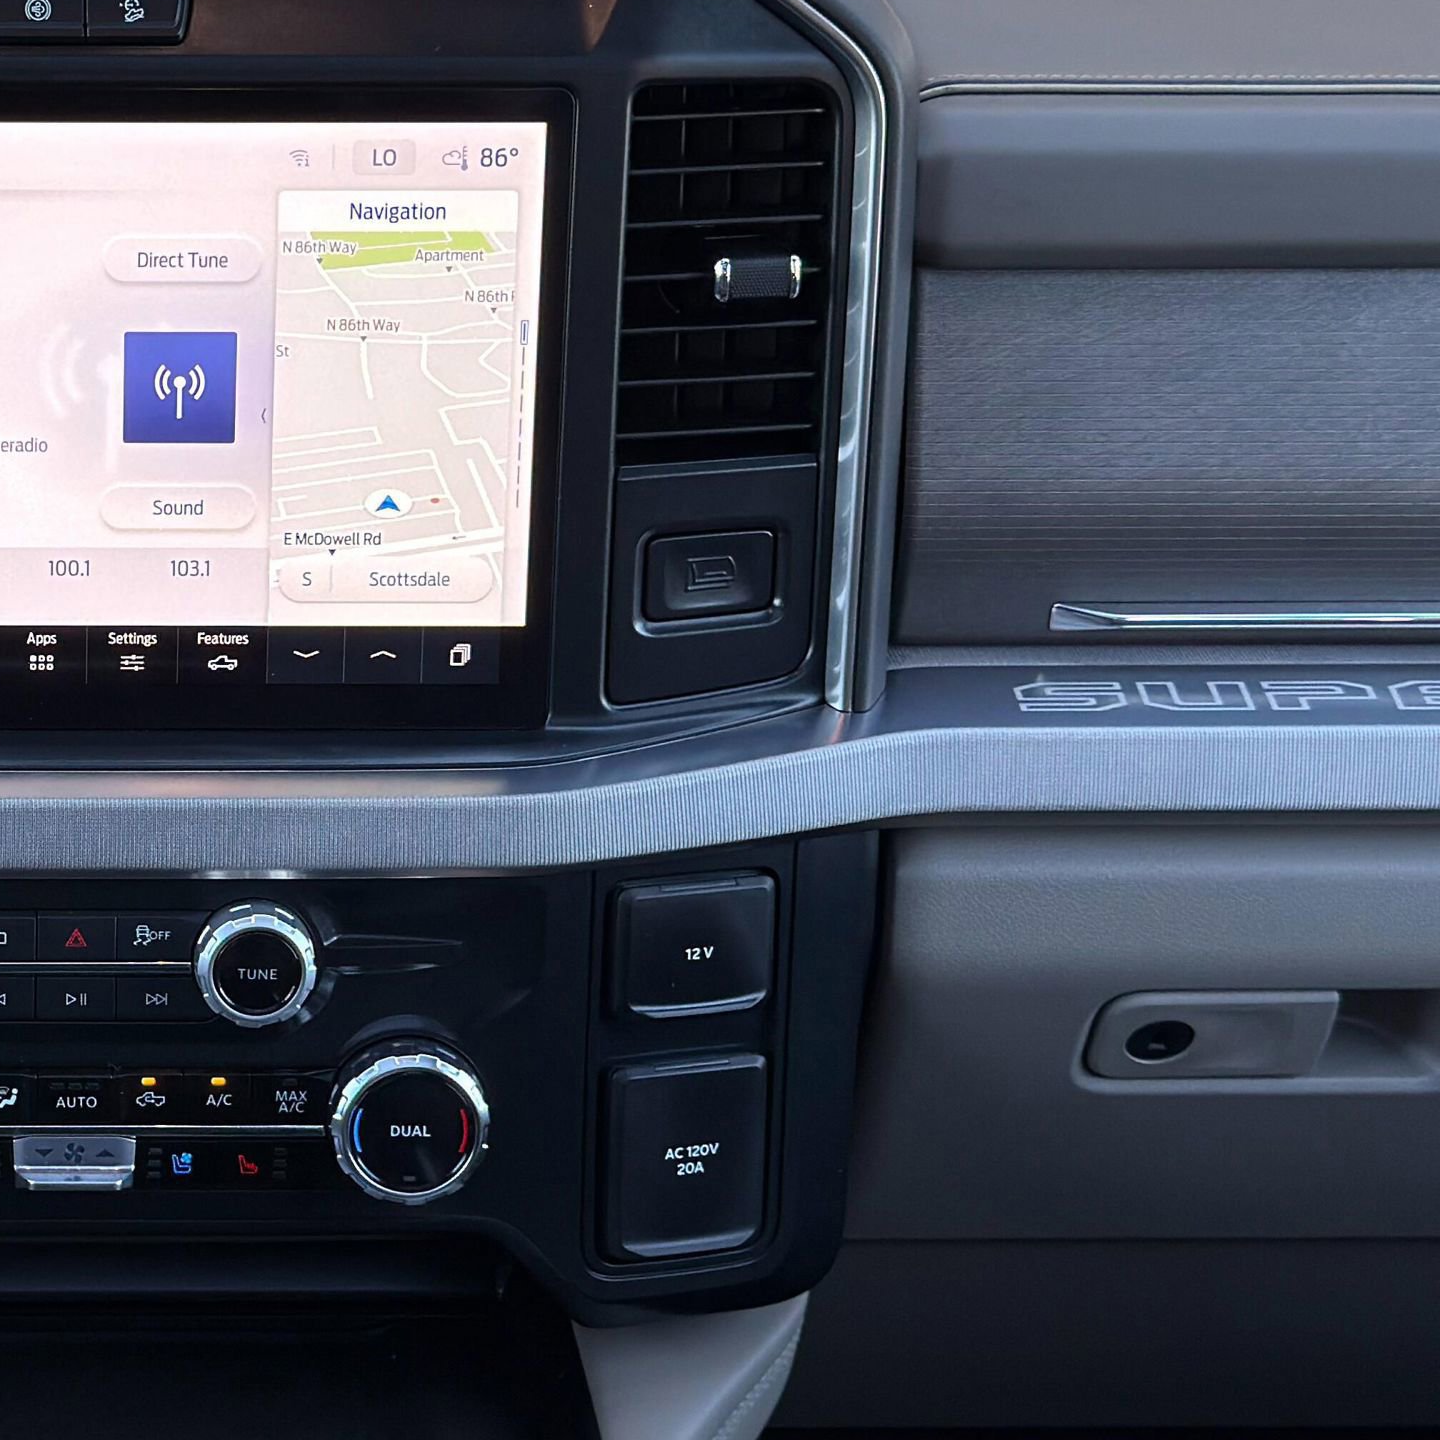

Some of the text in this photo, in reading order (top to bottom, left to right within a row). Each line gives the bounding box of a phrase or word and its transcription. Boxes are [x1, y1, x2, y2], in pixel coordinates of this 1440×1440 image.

[373, 149, 396, 166] LO
[480, 148, 518, 167] 86°
[350, 203, 446, 223] Navigation
[283, 240, 356, 255] N 86th Way
[137, 252, 228, 268] Direct Tune
[415, 249, 484, 263] Apartment
[465, 291, 474, 303] N
[477, 290, 507, 303] 86th
[327, 318, 400, 333] N 86th Way
[276, 345, 289, 357] St
[153, 501, 204, 515] Sound
[284, 532, 381, 545] E McDowell Rd
[48, 560, 90, 576] 100.1
[171, 561, 210, 576] 103.1
[302, 573, 311, 586] S
[369, 572, 450, 587] Scottsdale
[27, 632, 56, 647] Apps
[108, 632, 157, 648] Settings
[197, 632, 248, 646] Features
[149, 930, 171, 941] OFF
[685, 946, 714, 960] 12 V
[237, 968, 278, 980] TUNE
[56, 1096, 97, 1109] AUTO
[206, 1093, 232, 1107] A/C
[275, 1090, 307, 1103] MAX
[278, 1101, 304, 1113] A/C
[390, 1125, 431, 1138] DUAL
[665, 1142, 719, 1160] AC 120V
[677, 1162, 705, 1175] 20A
